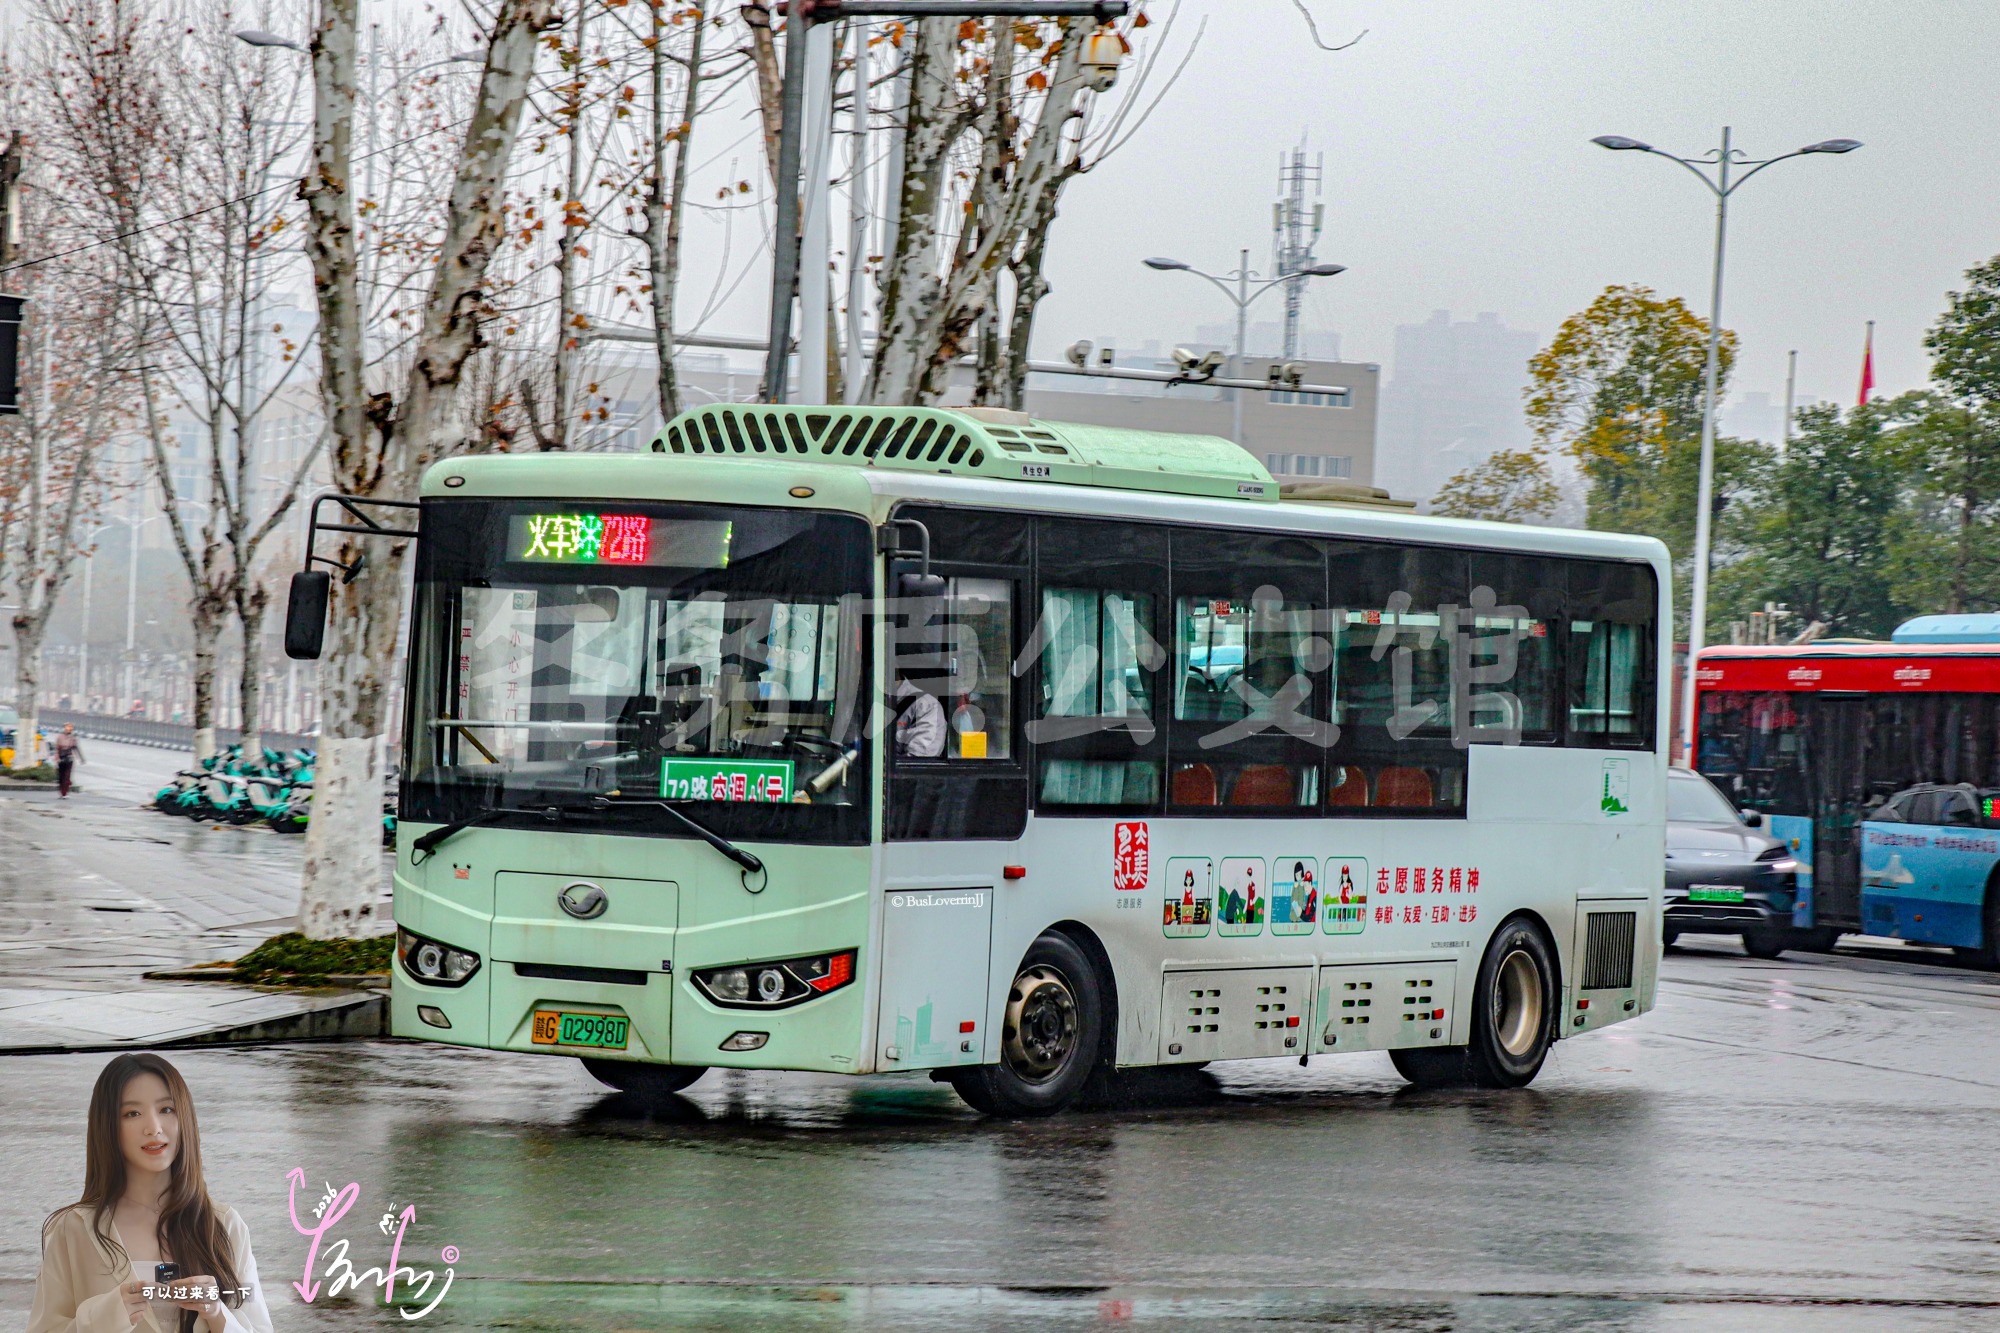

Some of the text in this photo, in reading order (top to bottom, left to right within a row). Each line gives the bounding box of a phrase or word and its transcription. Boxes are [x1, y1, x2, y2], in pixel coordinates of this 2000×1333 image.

[1376, 866, 1480, 894] 志愿服务精神
